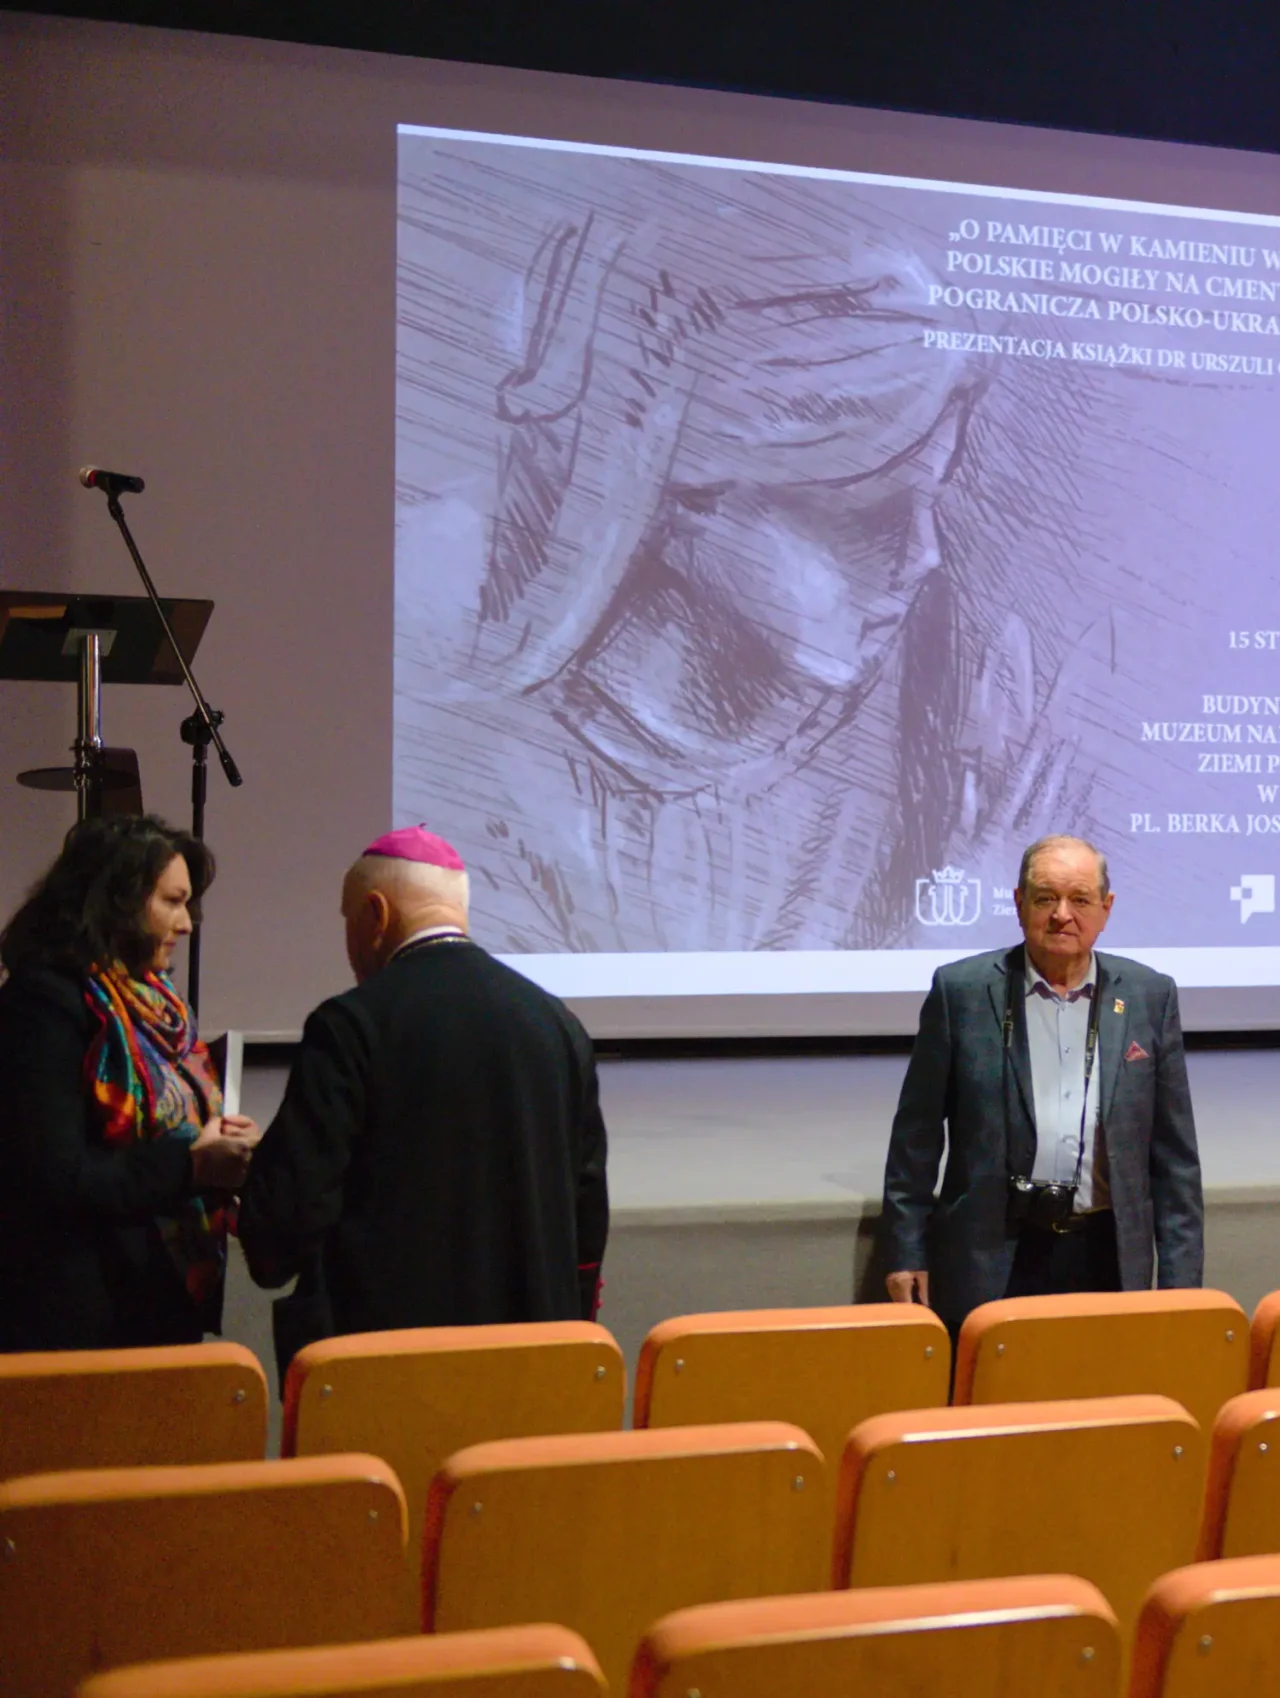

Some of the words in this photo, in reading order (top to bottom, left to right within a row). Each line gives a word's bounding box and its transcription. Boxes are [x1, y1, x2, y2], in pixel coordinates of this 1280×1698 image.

[948, 219, 980, 243] „O
[987, 221, 1092, 255] PAMIĘCI
[1099, 232, 1123, 254] W
[1130, 236, 1256, 268] KAMIENIU
[946, 251, 1053, 280] POLSKIE
[1059, 261, 1158, 292] MOGIŁY
[1165, 273, 1199, 295] NA
[927, 286, 1101, 320] POGRANICZA
[922, 329, 1066, 361] PREZENTACJA
[1072, 342, 1152, 370] KSIĄŻKI
[1158, 349, 1185, 368] DR
[1191, 352, 1273, 376] URSZULI
[1228, 632, 1250, 649] 15
[1141, 722, 1241, 744] MUZEUM
[1198, 753, 1262, 773] ZIEMI
[1257, 784, 1278, 803] W
[1130, 813, 1162, 834] PL.
[1167, 813, 1240, 834] BERKA
